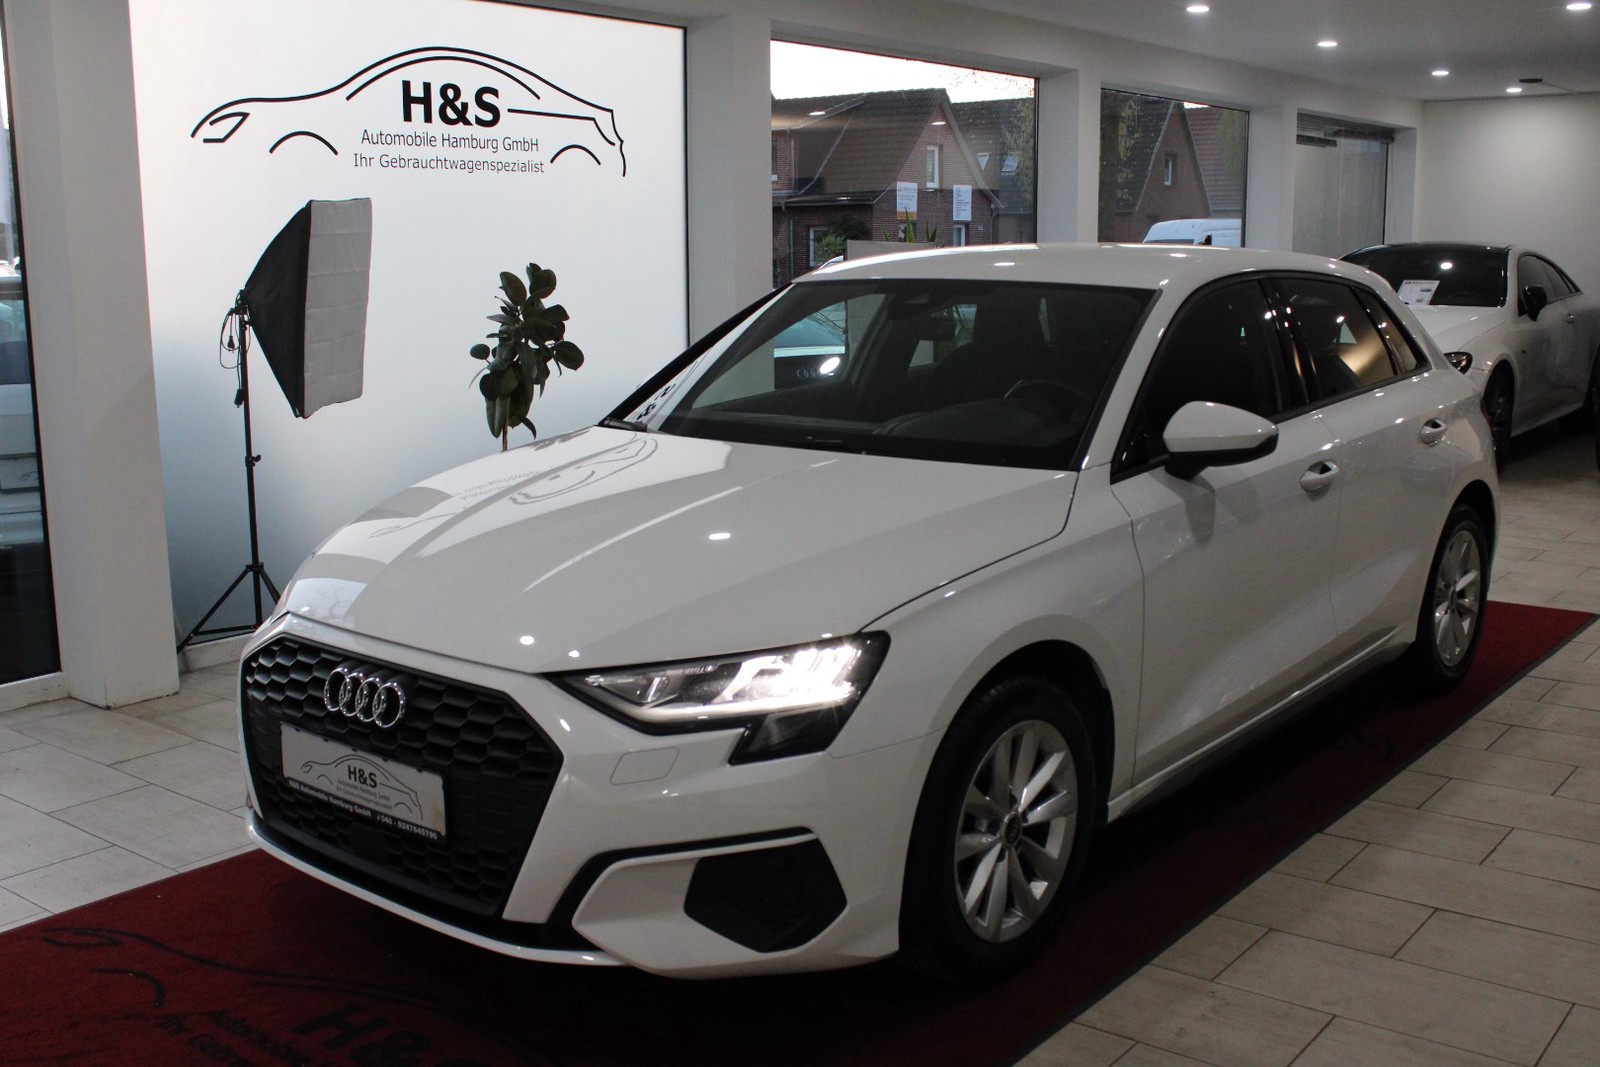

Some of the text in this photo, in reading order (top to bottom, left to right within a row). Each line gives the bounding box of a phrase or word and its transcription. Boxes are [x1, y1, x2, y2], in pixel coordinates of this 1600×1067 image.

[401, 79, 501, 128] H&S
[360, 129, 539, 153] Automobile Hamburg GmbH
[353, 153, 545, 174] Ihr Gebrauchtwagenspezialist
[347, 764, 378, 788] H&S
[353, 804, 372, 817] GmbH
